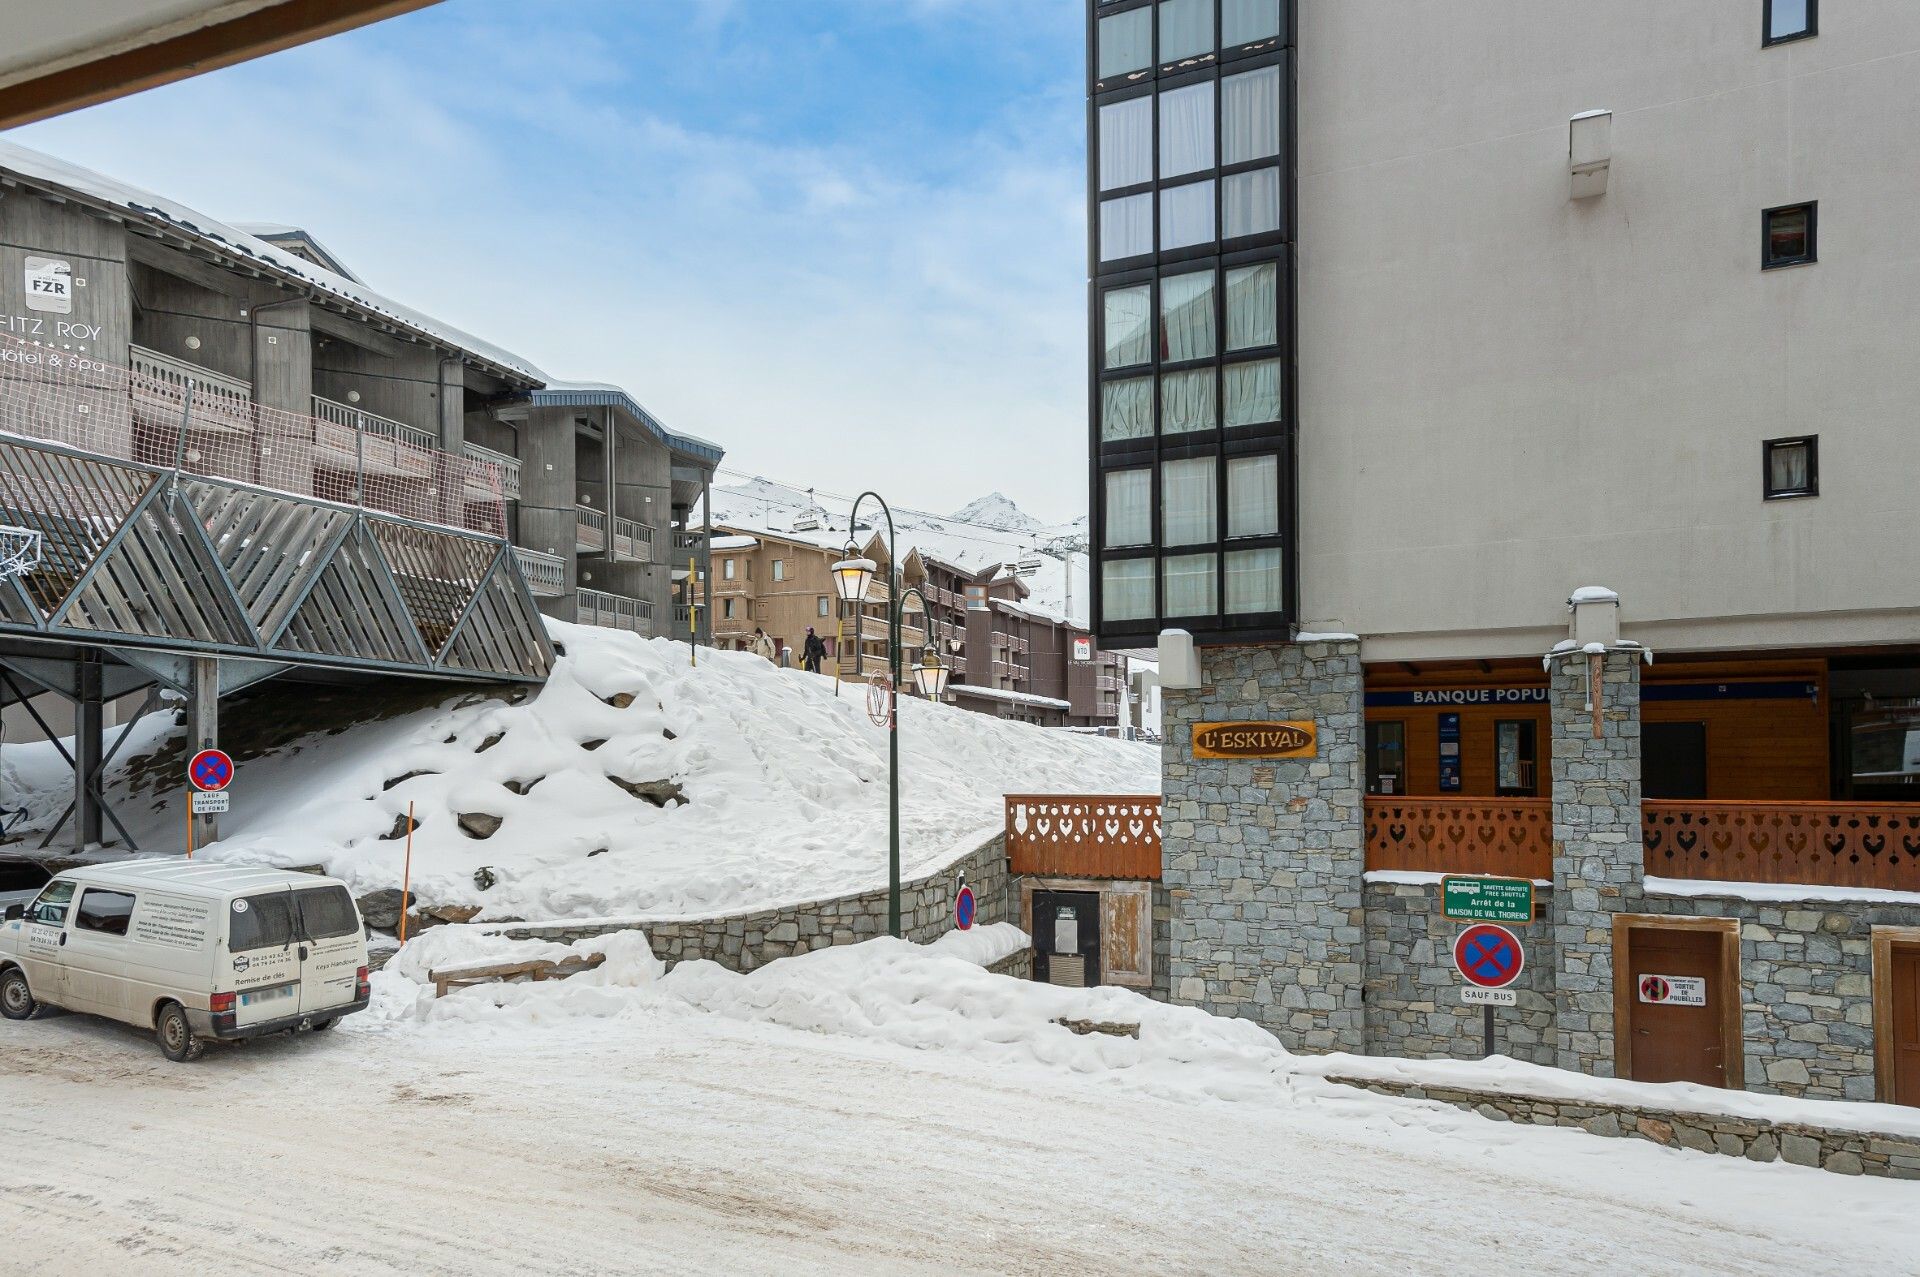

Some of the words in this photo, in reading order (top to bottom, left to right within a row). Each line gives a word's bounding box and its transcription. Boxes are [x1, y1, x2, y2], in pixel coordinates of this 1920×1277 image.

[33, 280, 65, 294] FZR
[57, 321, 101, 340] ROY
[49, 353, 62, 367] &
[69, 357, 104, 371] spa
[1413, 690, 1489, 703] BANQUE
[1205, 731, 1304, 748] L'ESKIVAL
[1471, 899, 1491, 907] Arrêt
[1447, 908, 1473, 916] MAISON
[1485, 910, 1496, 918] VAL
[1498, 911, 1528, 920] THORENS
[235, 977, 260, 986] Remise
[1465, 990, 1489, 999] SAUF
[1494, 992, 1512, 1000] BUS
[1670, 995, 1702, 1003] POUBELLES
